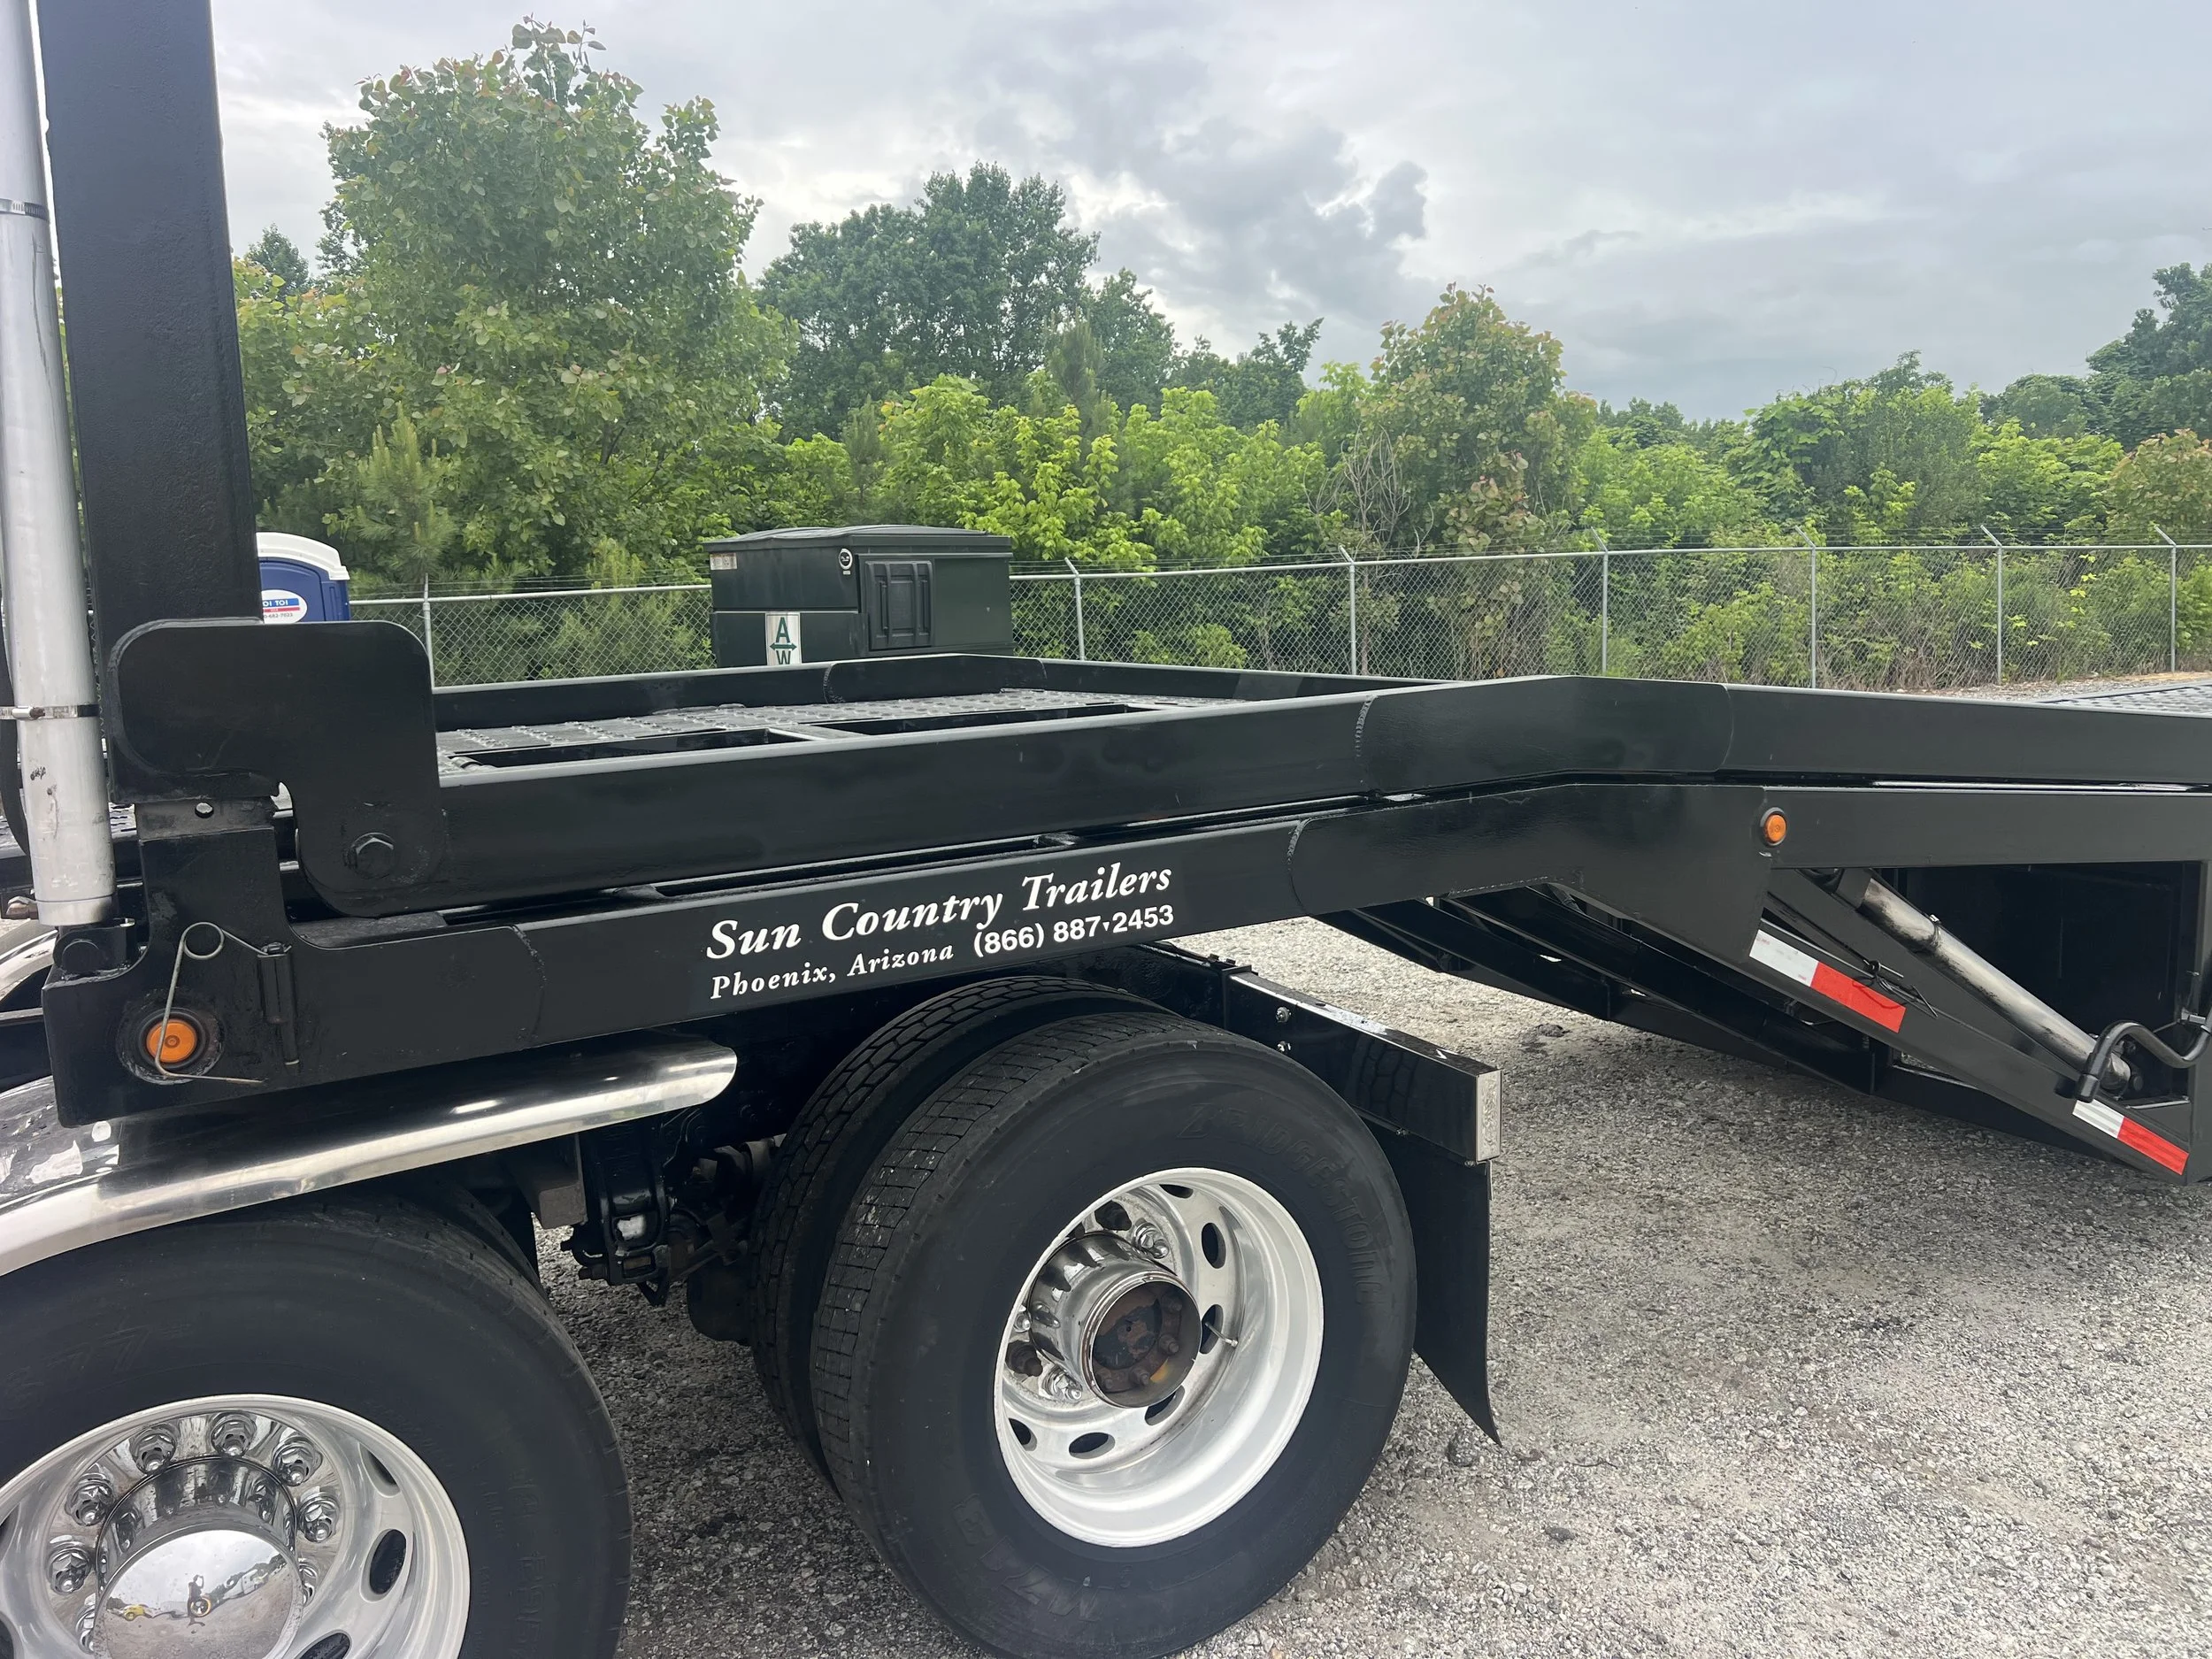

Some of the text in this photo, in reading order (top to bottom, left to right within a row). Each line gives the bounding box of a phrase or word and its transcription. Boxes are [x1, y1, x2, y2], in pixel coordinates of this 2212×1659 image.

[775, 616, 791, 643] A
[775, 649, 791, 665] W
[706, 862, 1172, 959] Sun Country Trailers
[973, 922, 1045, 958] (866)
[710, 944, 954, 1000] Phoenix, Arizona
